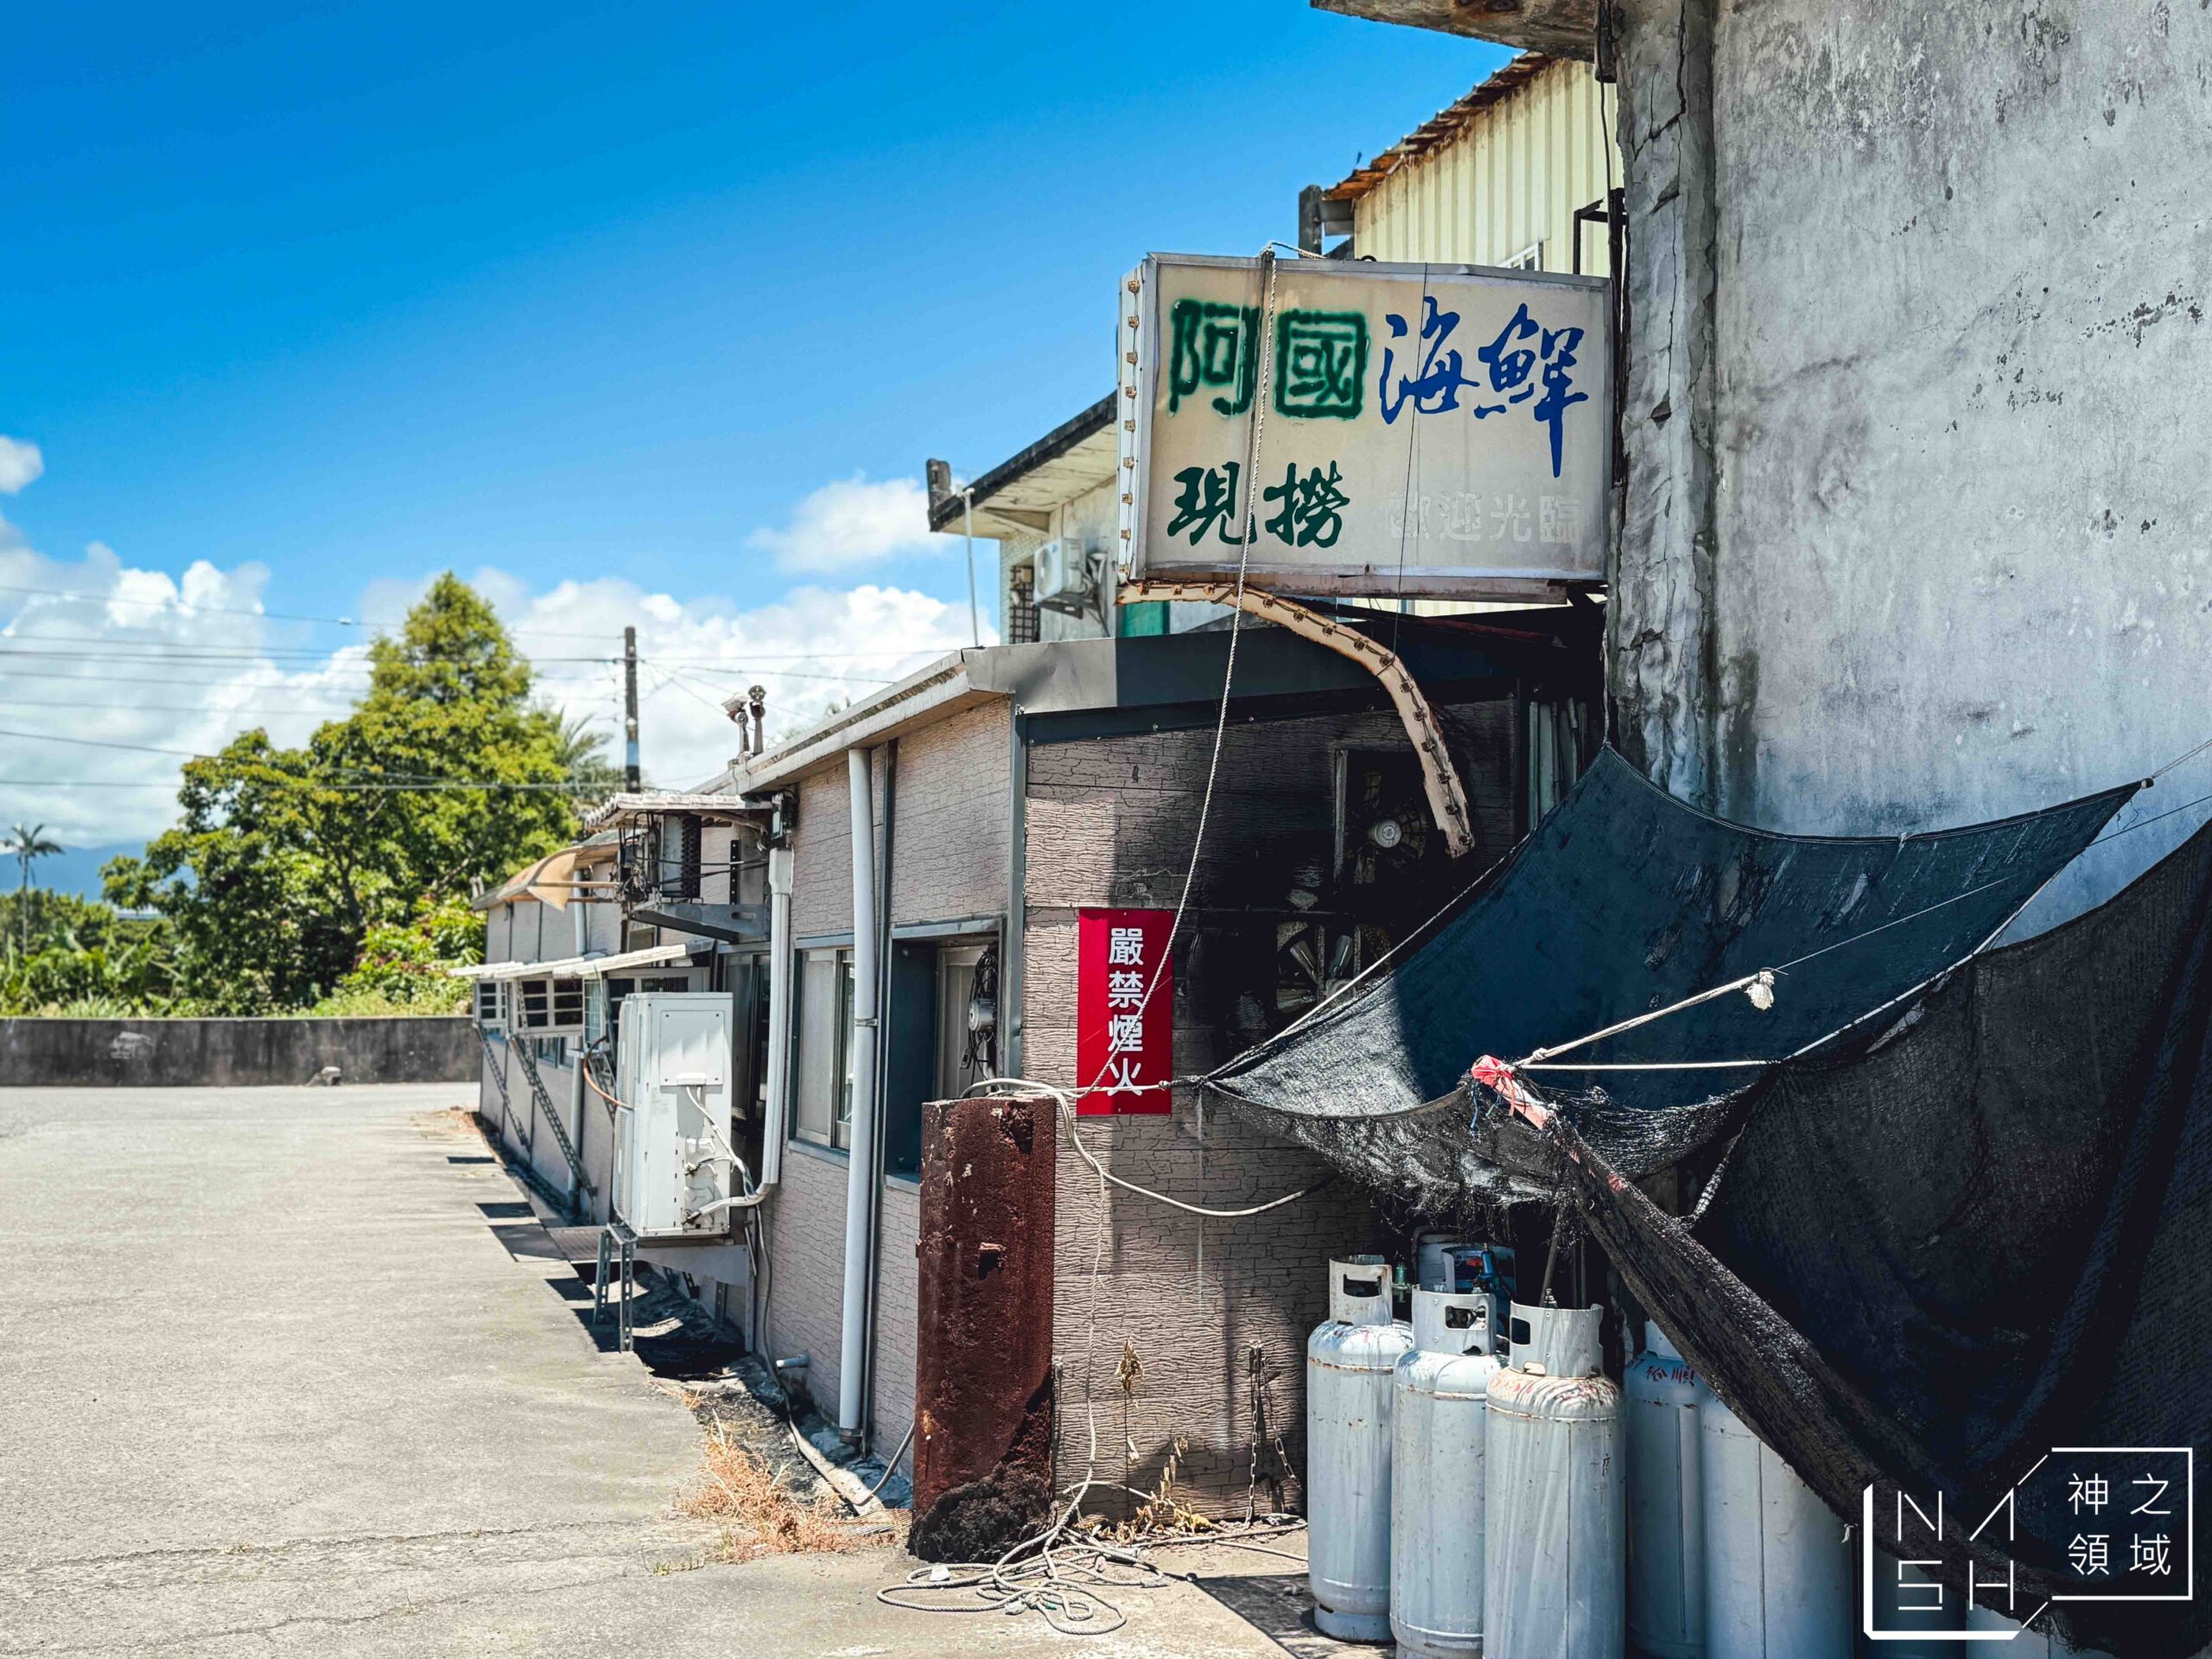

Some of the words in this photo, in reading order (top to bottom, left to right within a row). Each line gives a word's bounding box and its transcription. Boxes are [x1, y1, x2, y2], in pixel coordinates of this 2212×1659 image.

[1169, 296, 1588, 478] 阿國海鮮
[1167, 461, 1351, 548] 現撈
[1108, 928, 1144, 1096] 嚴禁煙火
